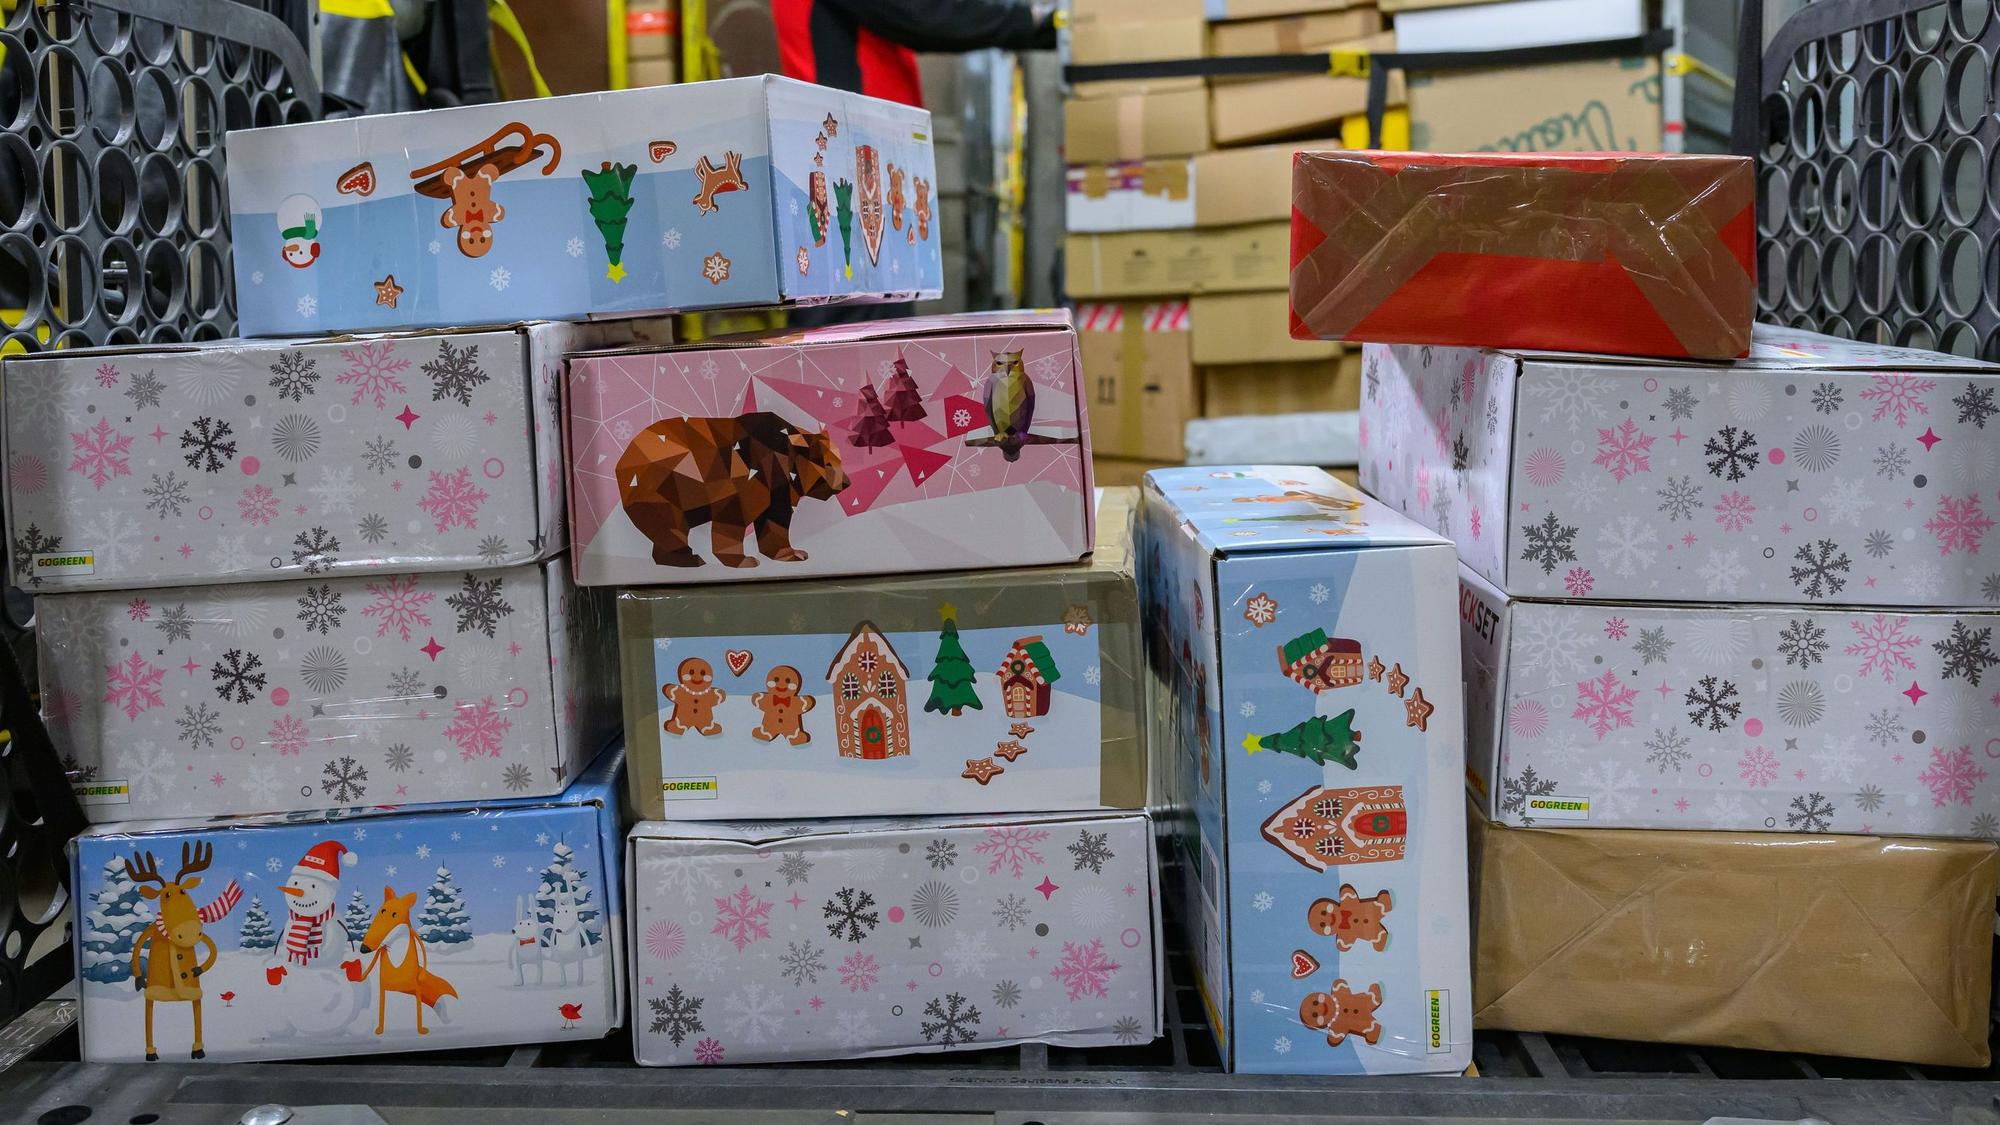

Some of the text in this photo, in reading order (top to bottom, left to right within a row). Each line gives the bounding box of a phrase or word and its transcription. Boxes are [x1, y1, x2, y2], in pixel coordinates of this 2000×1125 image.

[37, 556, 86, 567] GOGREEN
[662, 781, 710, 791] GOGREEN
[1530, 800, 1582, 811] GOGREEN
[1431, 998, 1440, 1048] GOGREEN
